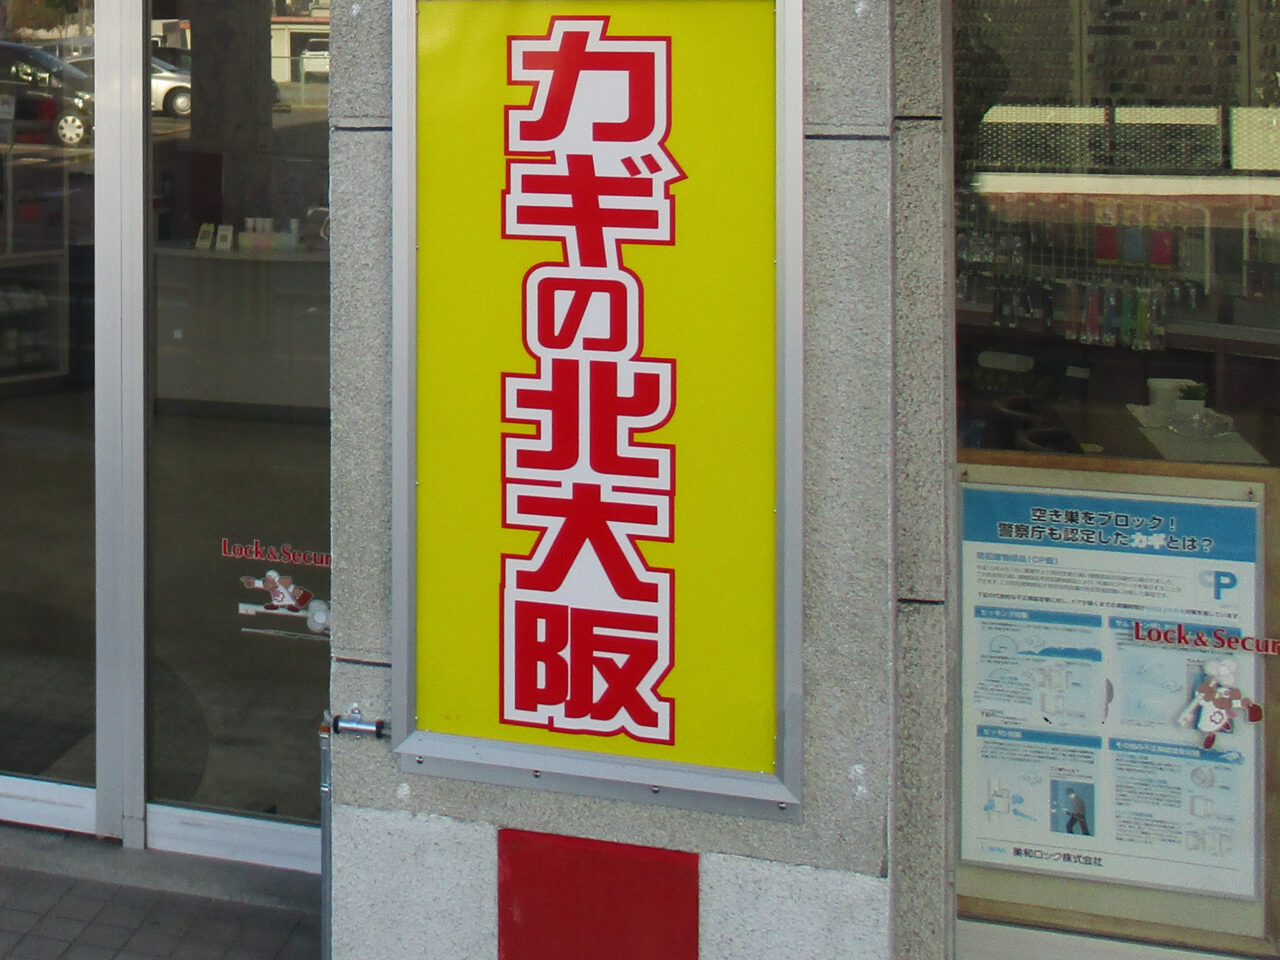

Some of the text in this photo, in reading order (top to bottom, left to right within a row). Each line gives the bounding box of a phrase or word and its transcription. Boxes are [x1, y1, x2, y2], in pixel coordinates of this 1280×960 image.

[510, 26, 670, 734] カギの北大阪
[1030, 507, 1177, 532] 空き巣をブロック！
[1133, 621, 1191, 646] Lock
